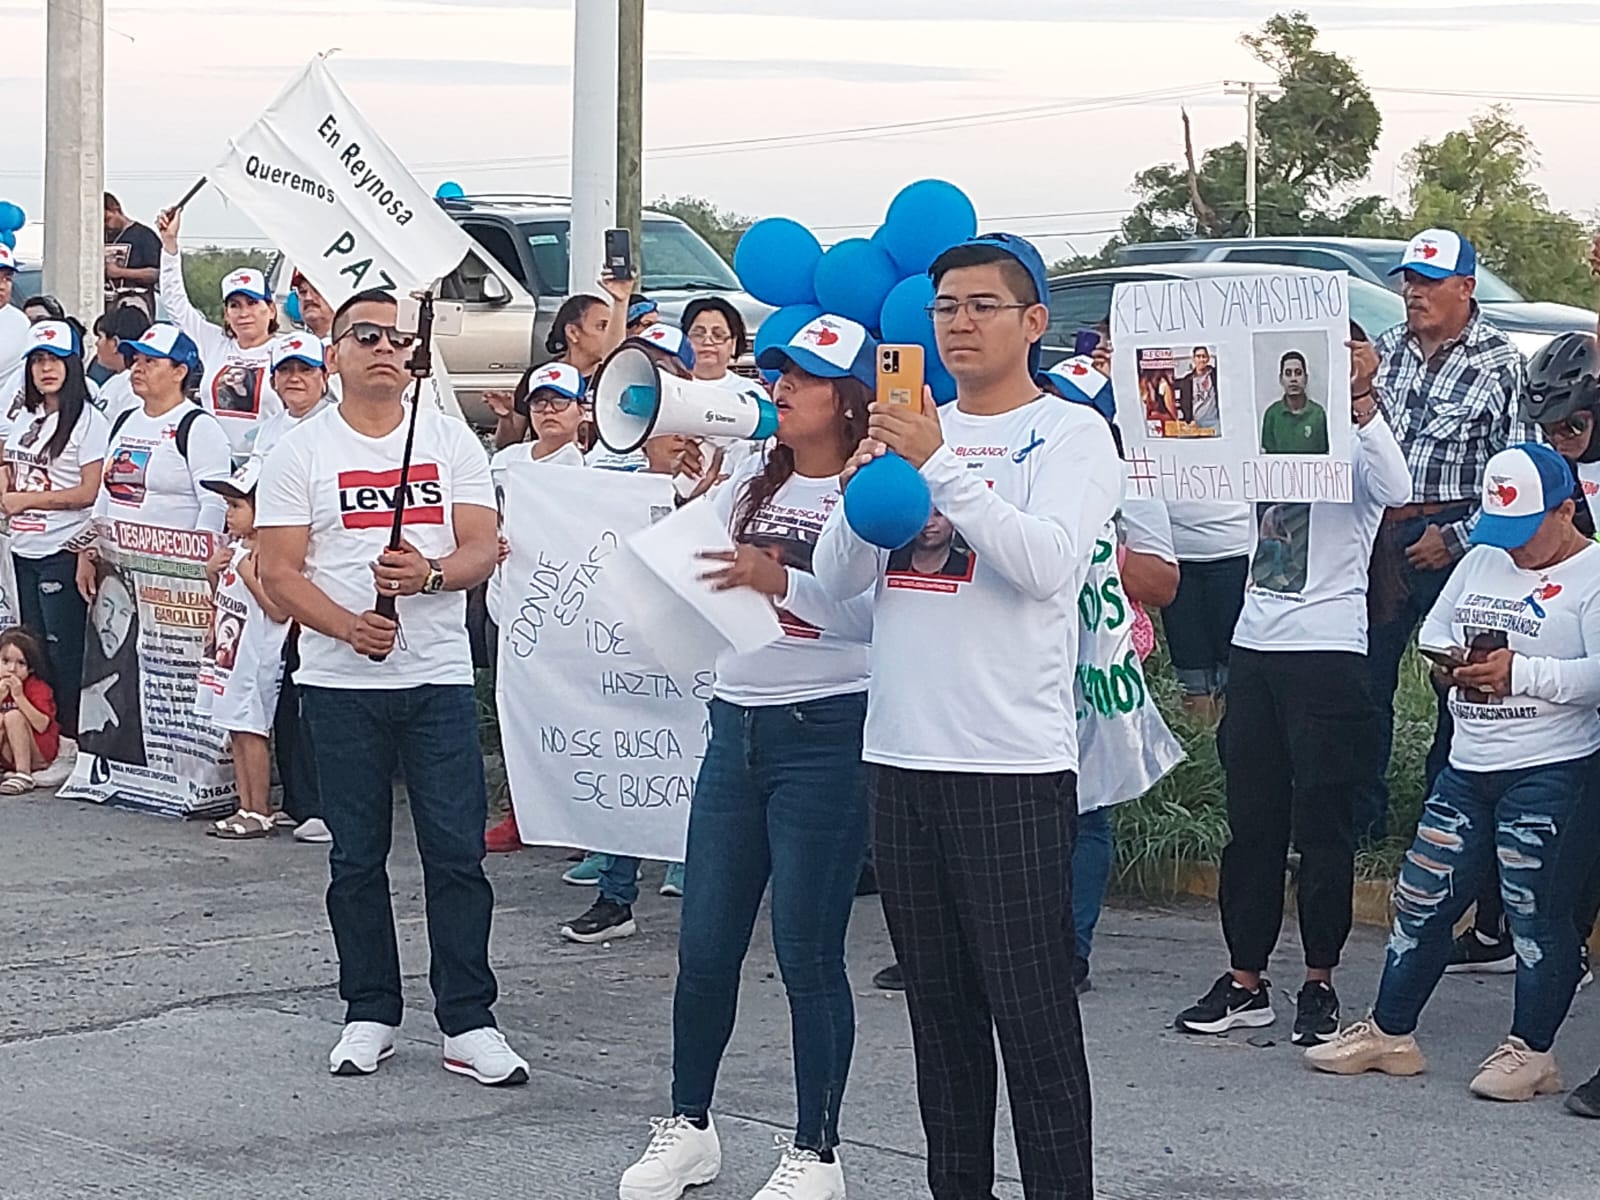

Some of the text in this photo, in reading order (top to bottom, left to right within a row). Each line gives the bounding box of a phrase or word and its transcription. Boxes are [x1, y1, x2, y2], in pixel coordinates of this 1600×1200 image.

[245, 155, 335, 204] Queremos
[318, 114, 413, 226] En Reynosa
[1114, 275, 1343, 334] KEVIN YAMASHIRO
[119, 523, 208, 558] DESAPARECIDOS
[602, 670, 683, 699] HAZTA
[541, 726, 566, 753] NO
[569, 730, 603, 759] SE
[614, 729, 682, 760] BUSCA
[571, 771, 615, 810] SE
